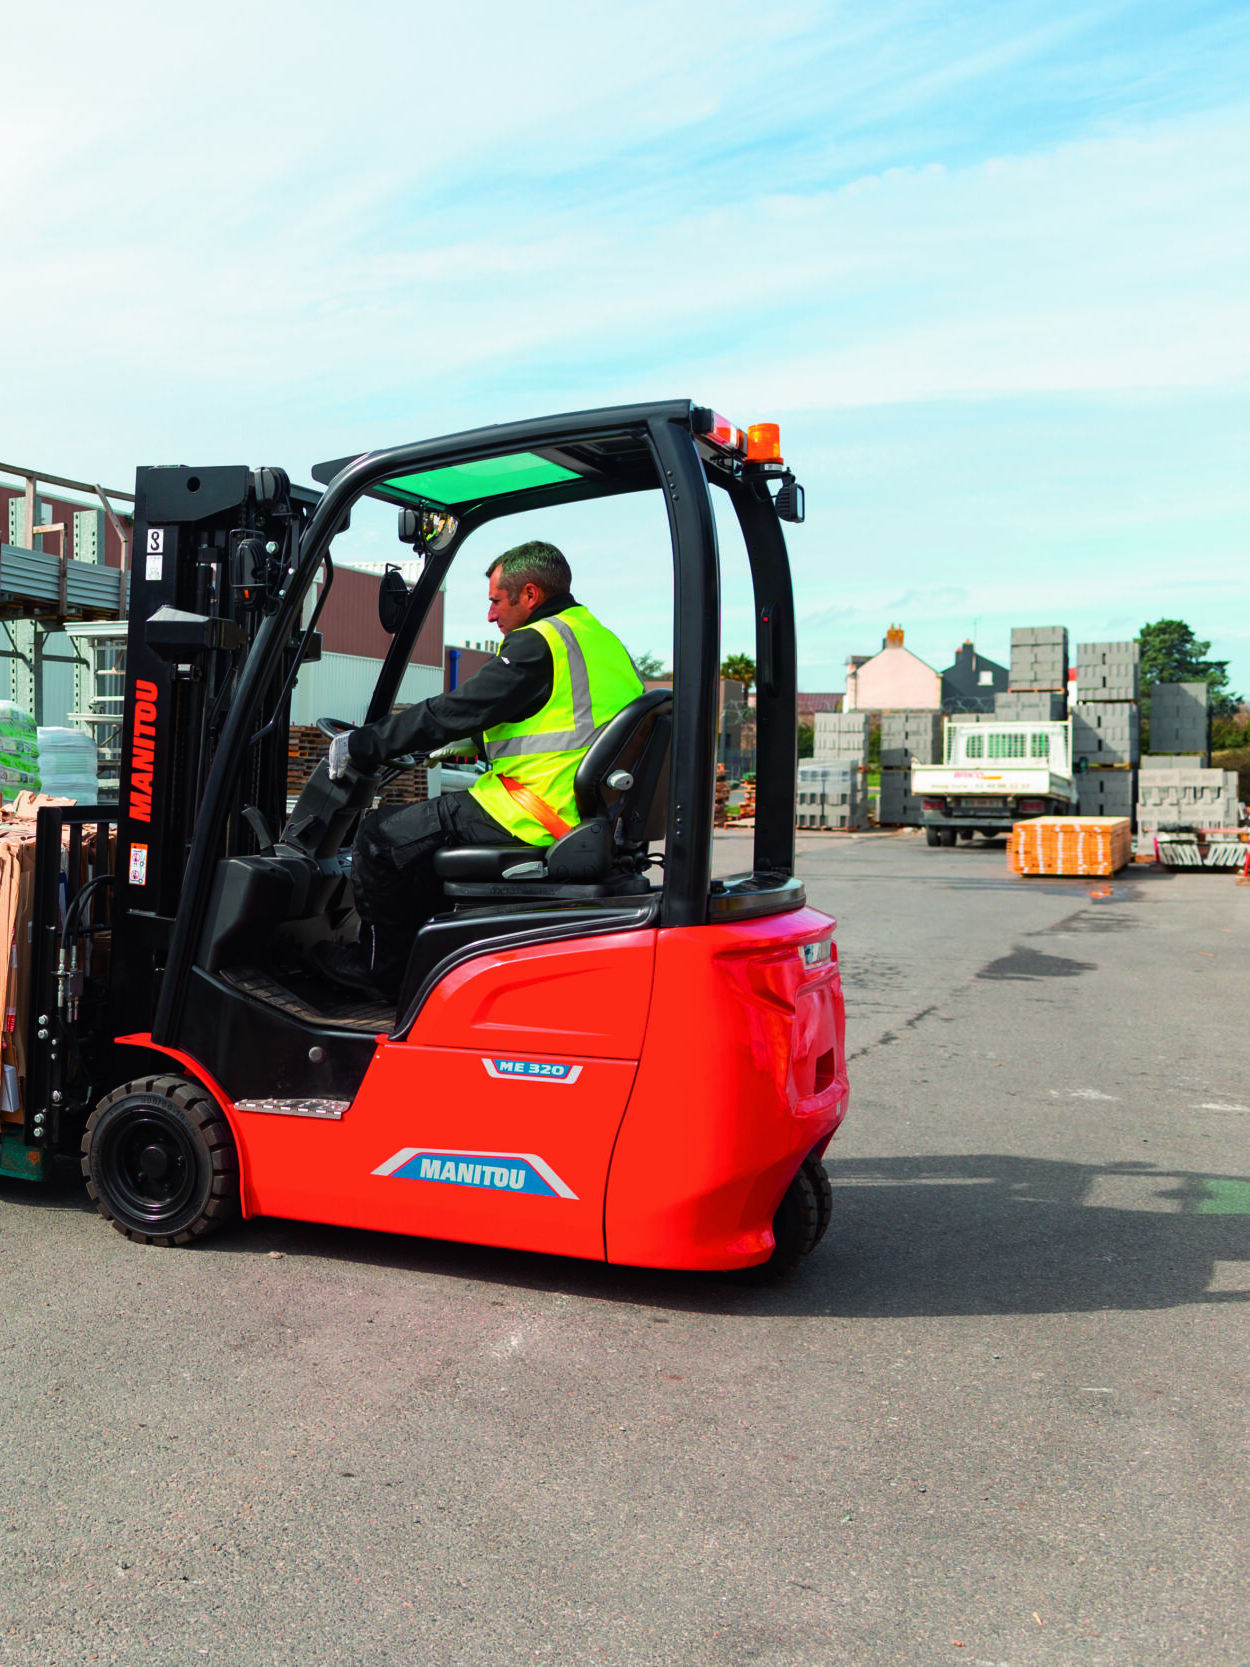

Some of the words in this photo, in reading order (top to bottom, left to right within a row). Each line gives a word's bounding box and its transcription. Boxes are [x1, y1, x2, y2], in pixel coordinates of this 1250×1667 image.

[129, 679, 158, 823] MANITOU
[499, 1061, 525, 1073] ME
[528, 1063, 565, 1076] 320
[419, 1158, 526, 1190] MANITOU
